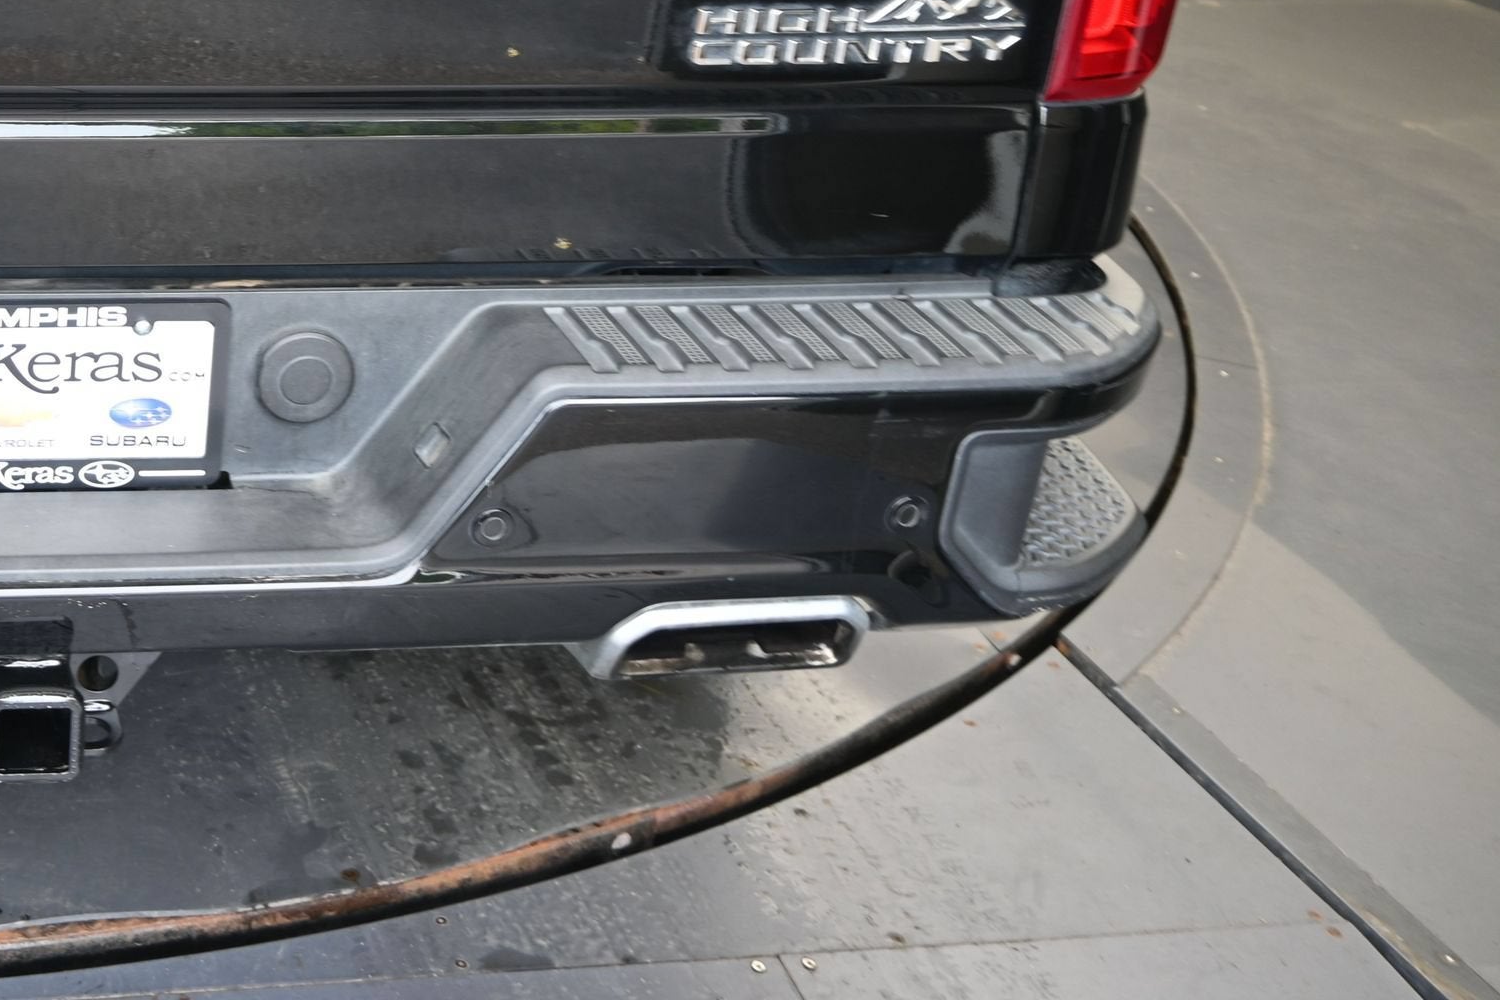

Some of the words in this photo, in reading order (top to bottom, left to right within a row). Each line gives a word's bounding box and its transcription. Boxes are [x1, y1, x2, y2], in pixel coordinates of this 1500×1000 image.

[694, 6, 867, 34] HIGH
[690, 34, 1022, 65] COUNTRY
[89, 434, 188, 448] SUBARU
